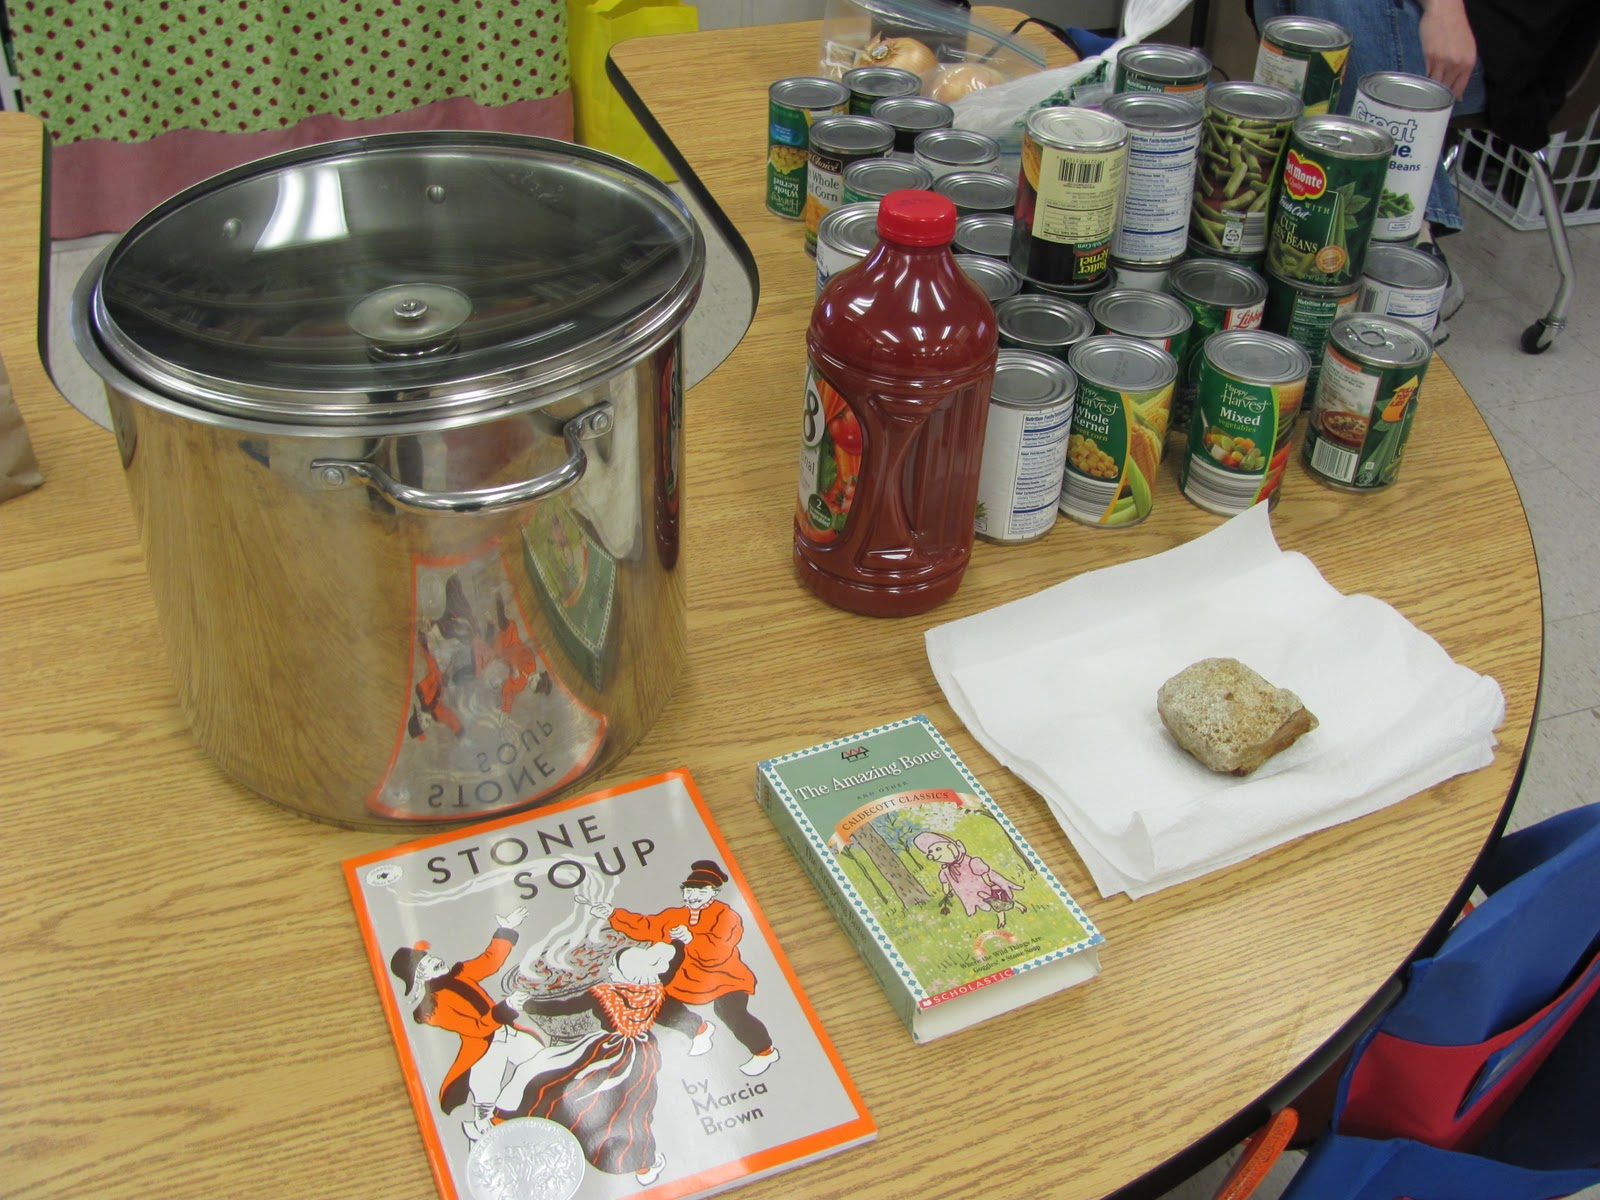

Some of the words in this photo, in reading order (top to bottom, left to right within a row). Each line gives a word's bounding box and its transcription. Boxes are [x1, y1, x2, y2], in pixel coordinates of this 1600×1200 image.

[1389, 160, 1421, 171] Beans
[773, 176, 799, 191] Kernel
[812, 170, 840, 190] Whole
[1292, 167, 1323, 189] Monte
[773, 184, 799, 199] Whole
[814, 184, 838, 202] Corn
[1291, 206, 1312, 220] Cut
[1304, 202, 1330, 215] WITH
[1280, 214, 1298, 234] CUT
[1285, 231, 1318, 254] BEANS
[1225, 382, 1249, 398] Happy
[1220, 389, 1271, 413] Harvest
[802, 388, 819, 443] 8
[1073, 412, 1109, 435] Kernel
[1075, 403, 1109, 425] Whole
[1220, 406, 1261, 426] Mixed
[1218, 418, 1257, 433] vegetables
[816, 498, 822, 510] 2
[794, 782, 830, 801] The
[832, 763, 902, 791] Amazing
[900, 749, 942, 770] Bone
[857, 791, 875, 800] AND
[878, 781, 908, 793] OTHER
[841, 799, 896, 831] CALDECOTT
[898, 791, 950, 804] CLASSICS
[427, 815, 606, 884] STONE
[513, 838, 656, 900] SOUP
[959, 957, 981, 969] Where
[992, 949, 1009, 958] Wild
[1008, 942, 1030, 951] Things
[933, 968, 1013, 1003] SCHOLASTIC
[681, 1078, 709, 1095] by
[691, 1082, 768, 1116] Marcia
[699, 1107, 764, 1136] Brown
